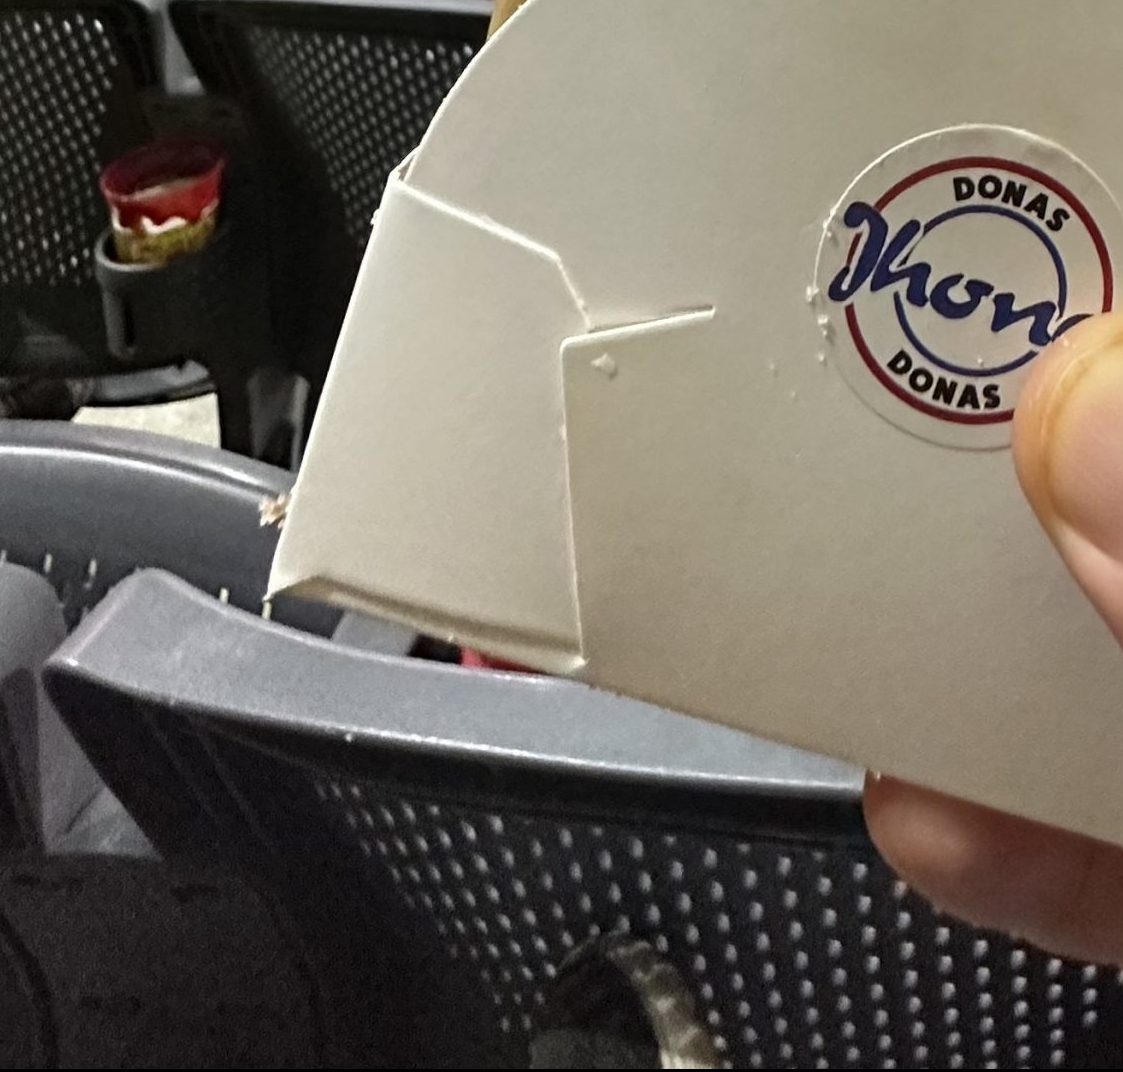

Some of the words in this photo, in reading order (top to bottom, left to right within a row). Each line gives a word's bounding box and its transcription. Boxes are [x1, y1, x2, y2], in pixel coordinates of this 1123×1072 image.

[953, 175, 1070, 231] DONAS
[829, 201, 1093, 346] Jhon
[887, 350, 1001, 409] DONAS
